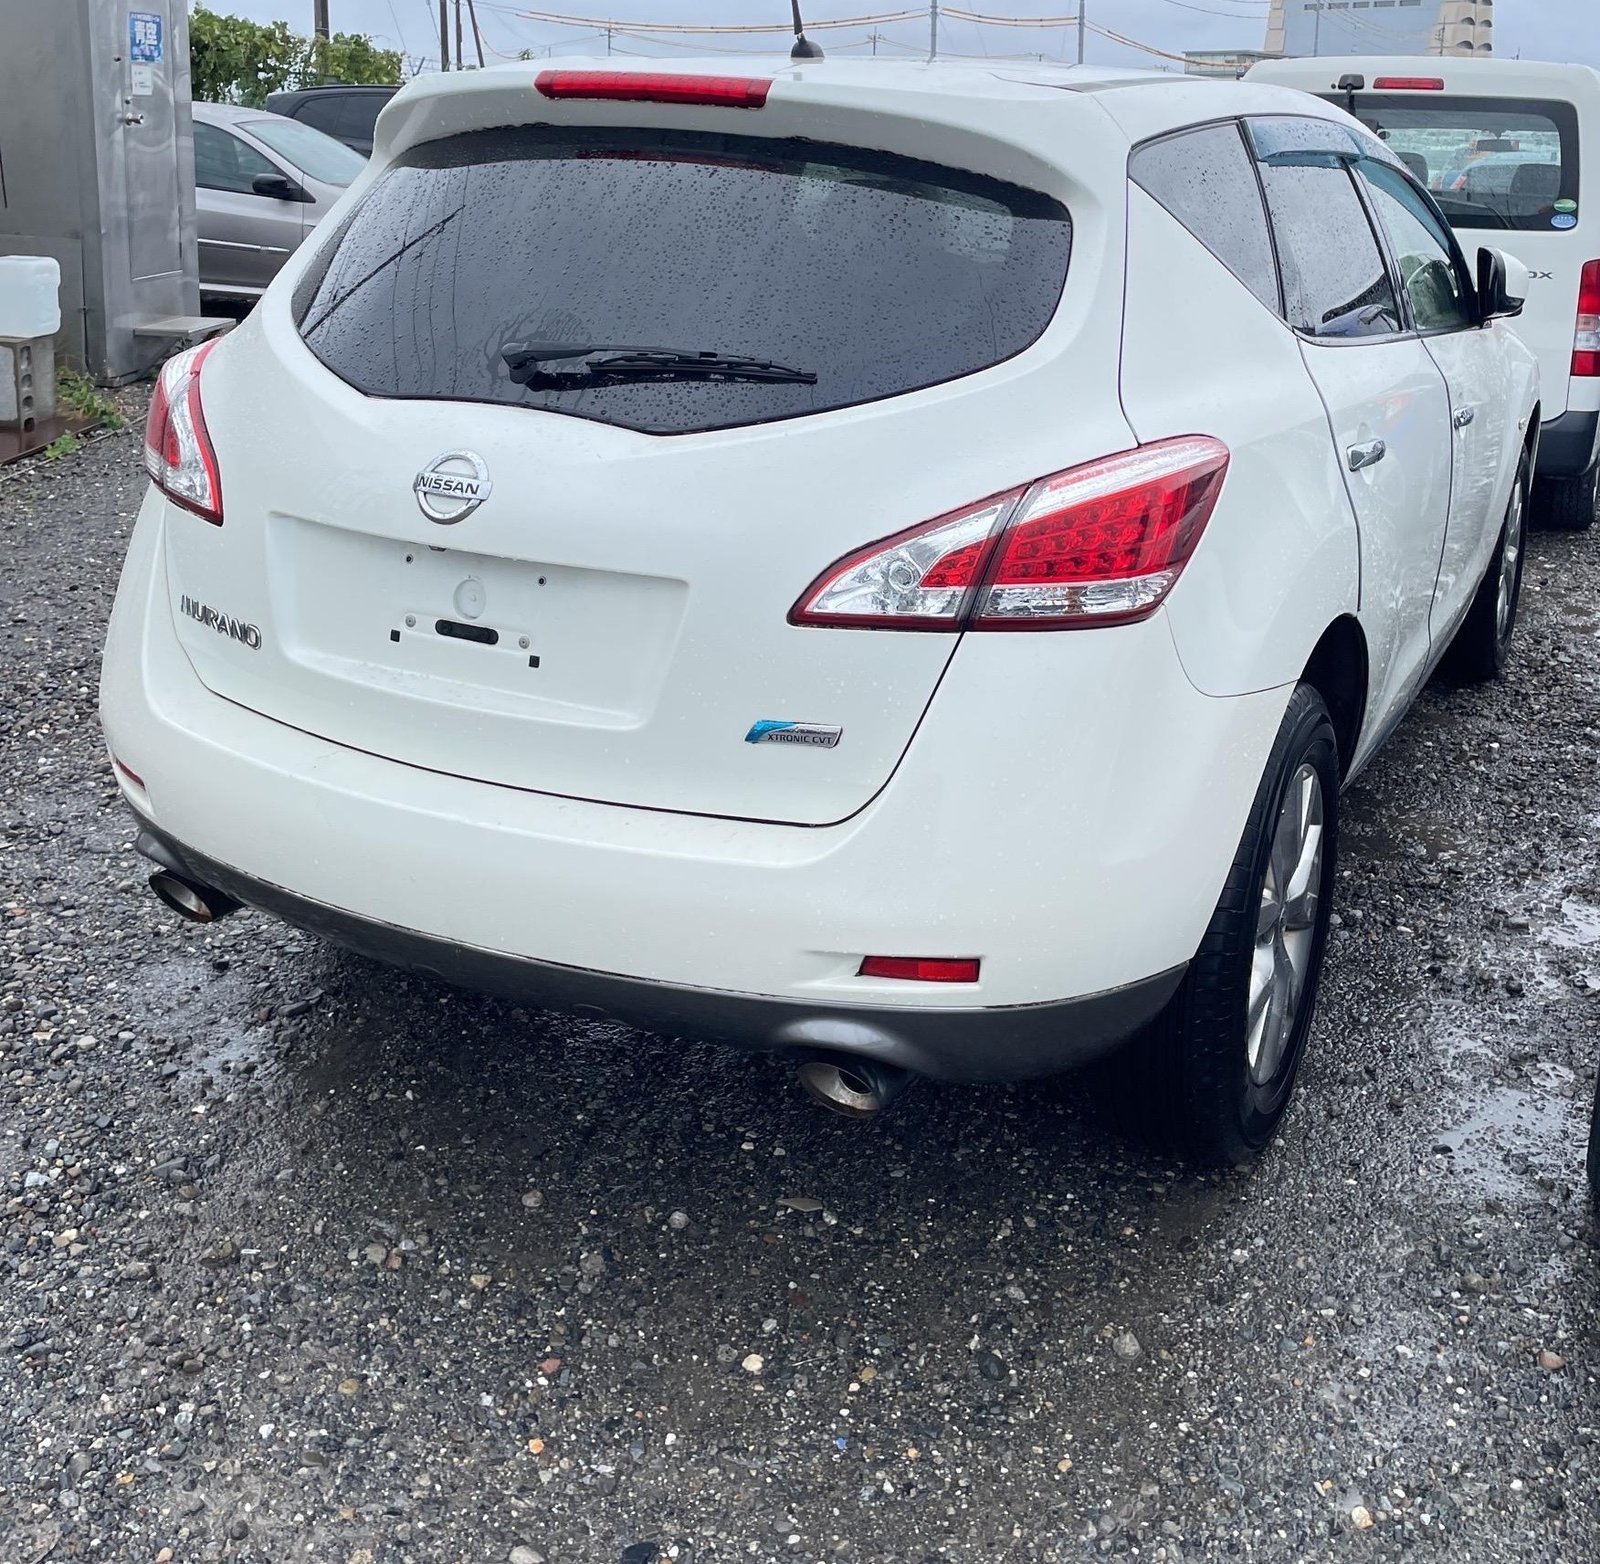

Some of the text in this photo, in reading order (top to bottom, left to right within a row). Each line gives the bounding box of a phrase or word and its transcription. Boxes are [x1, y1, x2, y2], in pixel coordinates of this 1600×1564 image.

[417, 475, 480, 495] NISSAN
[180, 594, 262, 650] MURANO
[767, 733, 832, 745] XTRONIC CVT
